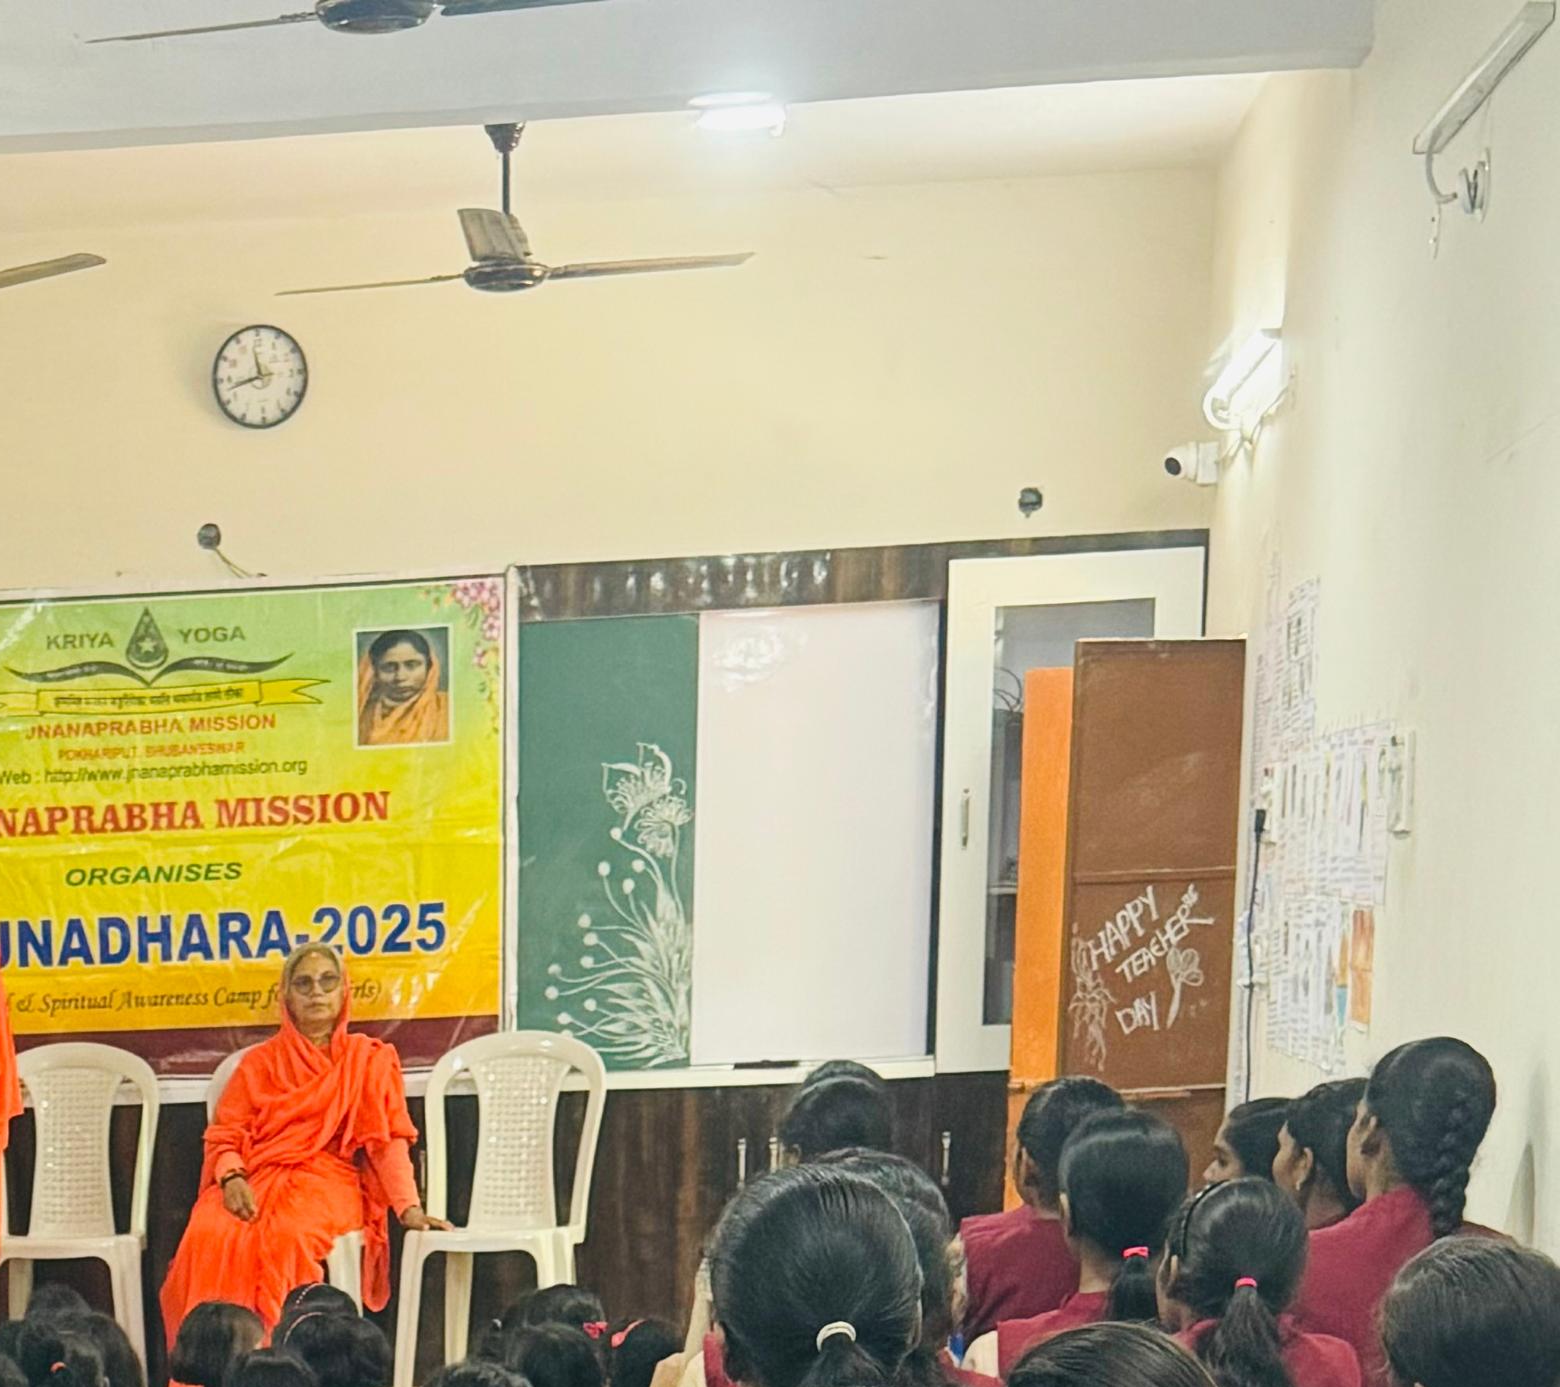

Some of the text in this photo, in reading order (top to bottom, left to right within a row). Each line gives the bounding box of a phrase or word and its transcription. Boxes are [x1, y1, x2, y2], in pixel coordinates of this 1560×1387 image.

[46, 632, 114, 650] KRIYA
[178, 626, 246, 644] YOGA
[26, 713, 277, 740] JNANAPRABHA MISSION
[216, 791, 390, 829] MISSION
[65, 861, 243, 887] ORGANISES
[1088, 885, 1159, 971] HAPPY
[38, 989, 116, 1018] Spiritual
[116, 990, 208, 1012] Awareness
[213, 986, 263, 1009] Camp
[1115, 990, 1160, 1035] DAY
